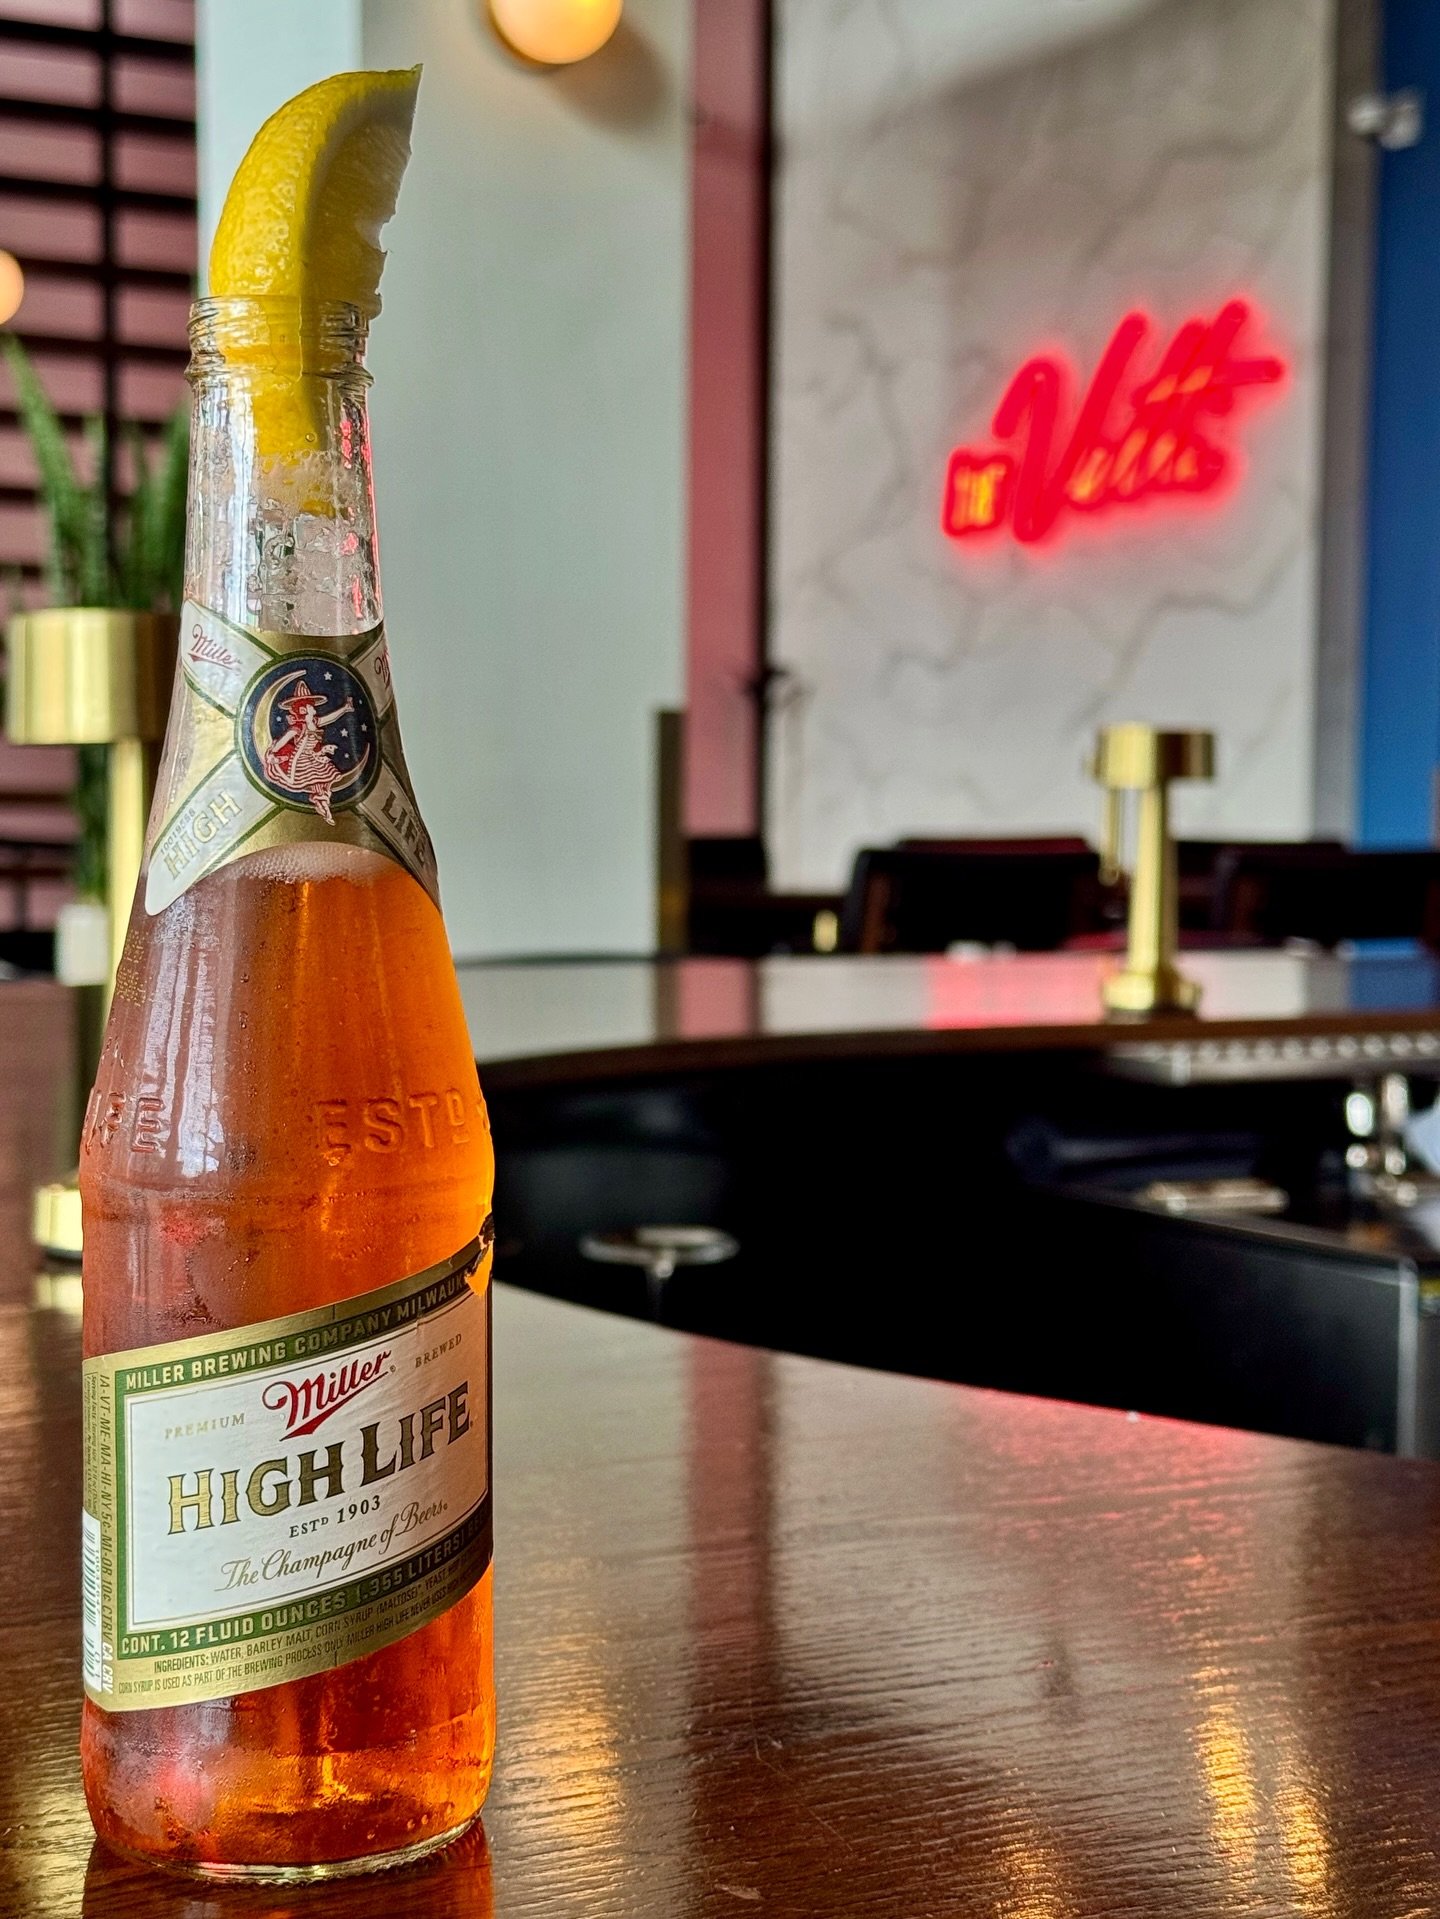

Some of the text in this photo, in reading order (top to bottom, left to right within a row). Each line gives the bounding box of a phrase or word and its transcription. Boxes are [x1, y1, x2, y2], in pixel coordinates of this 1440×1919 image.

[163, 791, 243, 880] HIGH
[126, 1365, 185, 1390] MILLER
[191, 1342, 287, 1379] BREWING
[294, 1307, 392, 1355] COMPANY
[415, 1333, 462, 1368] BREWED
[165, 1412, 246, 1440] PREMIUM
[262, 1350, 392, 1442] Miller
[167, 1441, 346, 1536] HIGH
[359, 1381, 470, 1488] LIFE
[337, 1495, 382, 1526] 1903
[214, 1556, 260, 1592] The
[261, 1534, 377, 1578] Champagne
[379, 1512, 400, 1554] of
[102, 1641, 113, 1661] CA
[122, 1634, 166, 1655] CONT.
[170, 1630, 190, 1649] 12
[195, 1617, 254, 1645] FLUID
[261, 1592, 347, 1630] OUNCES
[154, 1655, 210, 1674] INGREDIENTS:
[246, 1636, 283, 1657] BARLEY
[286, 1627, 314, 1647] MALT,
[315, 1620, 341, 1638] CORN
[343, 1607, 374, 1629] SYRUP
[102, 1664, 114, 1695] CRV
[118, 1681, 132, 1694] CORN
[133, 1679, 153, 1693] SYRUP
[154, 1679, 162, 1691] IS
[162, 1676, 180, 1690] USED
[182, 1674, 192, 1687] AS
[194, 1671, 214, 1686] PART
[216, 1669, 227, 1682] OF
[227, 1665, 242, 1680] THE
[244, 1656, 284, 1676] BREWING
[285, 1647, 323, 1667] PROCESS
